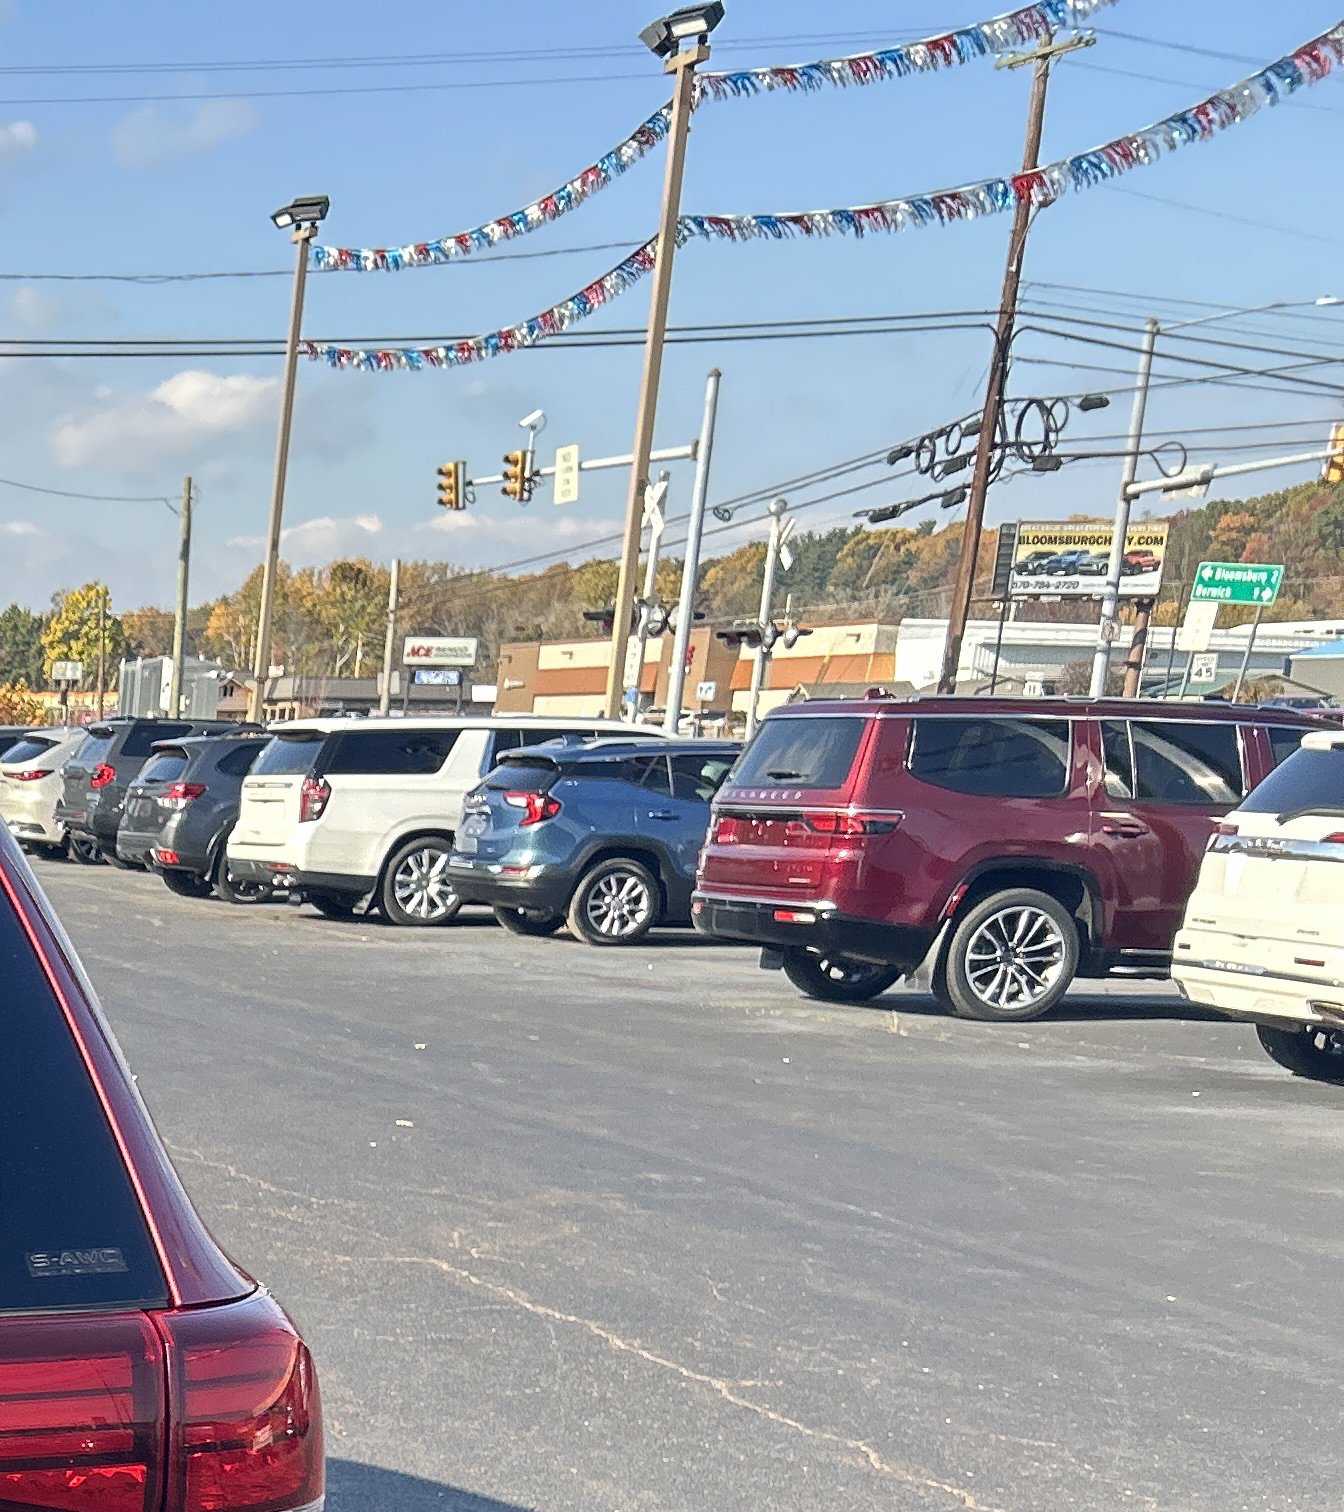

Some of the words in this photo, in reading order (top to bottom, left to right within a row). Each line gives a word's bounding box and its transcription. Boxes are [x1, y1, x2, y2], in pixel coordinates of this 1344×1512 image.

[1017, 534, 1164, 546] BLOOMSBURGCHY.COM
[1194, 667, 1213, 678] 45
[31, 1249, 120, 1268] S-AWC
